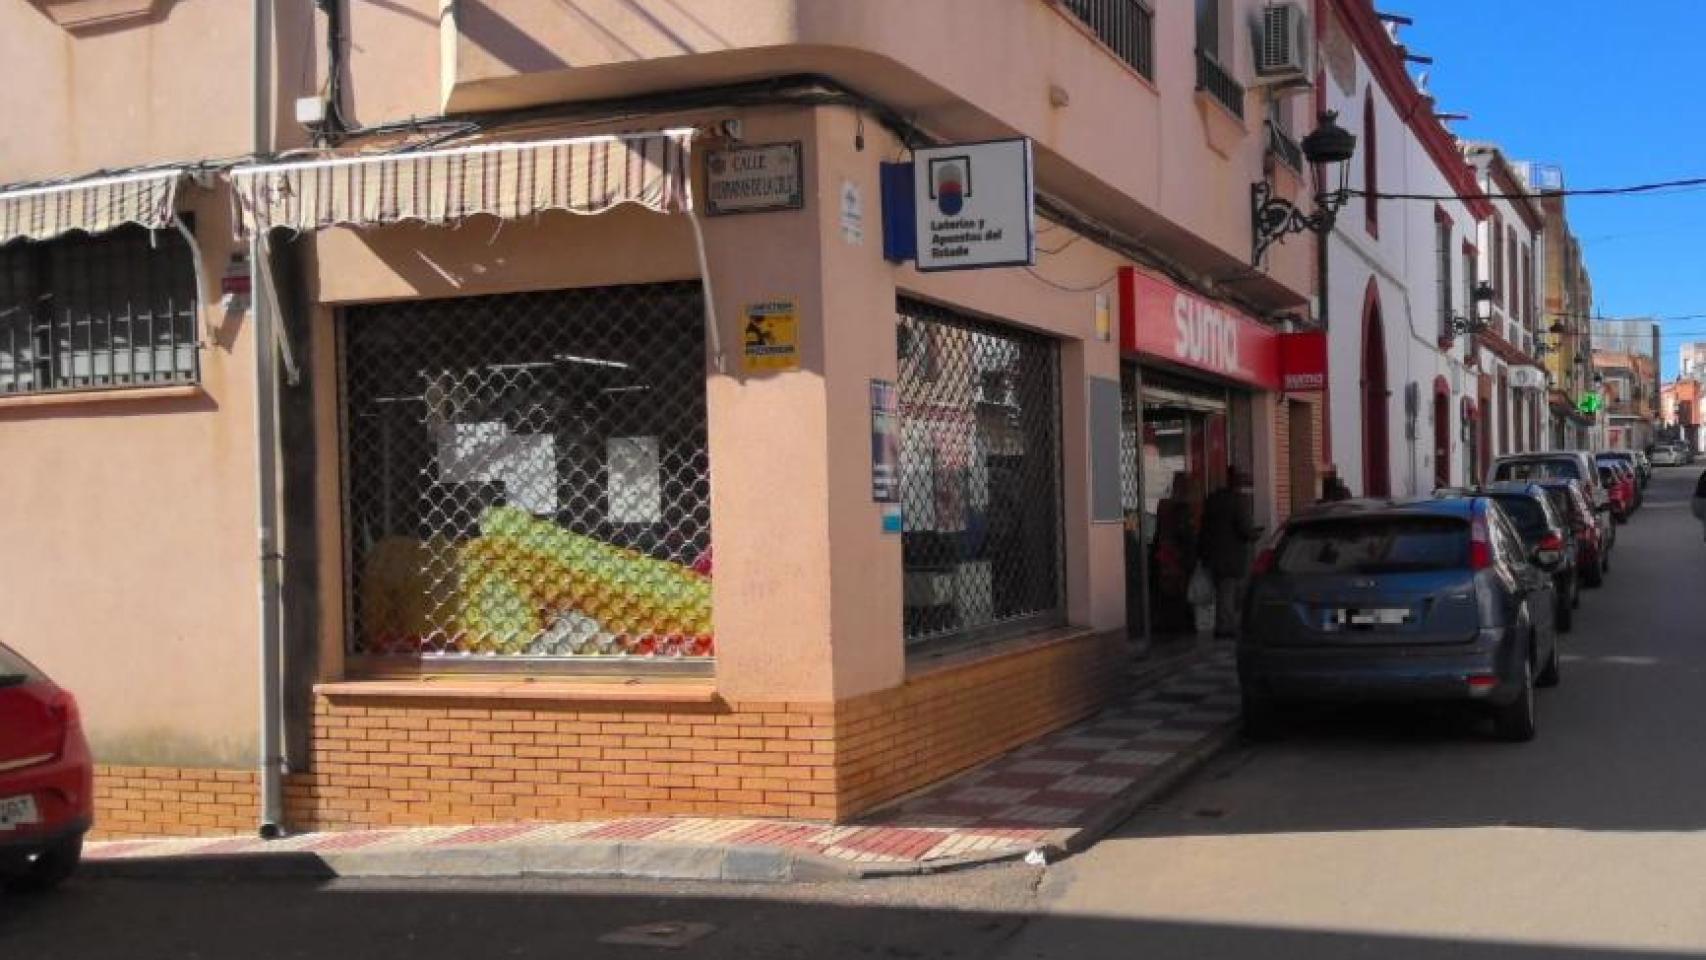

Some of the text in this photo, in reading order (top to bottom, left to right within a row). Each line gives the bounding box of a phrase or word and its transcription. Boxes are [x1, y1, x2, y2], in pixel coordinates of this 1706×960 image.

[732, 153, 767, 170] CALLE
[985, 229, 1002, 241] del
[931, 246, 969, 259] Estado
